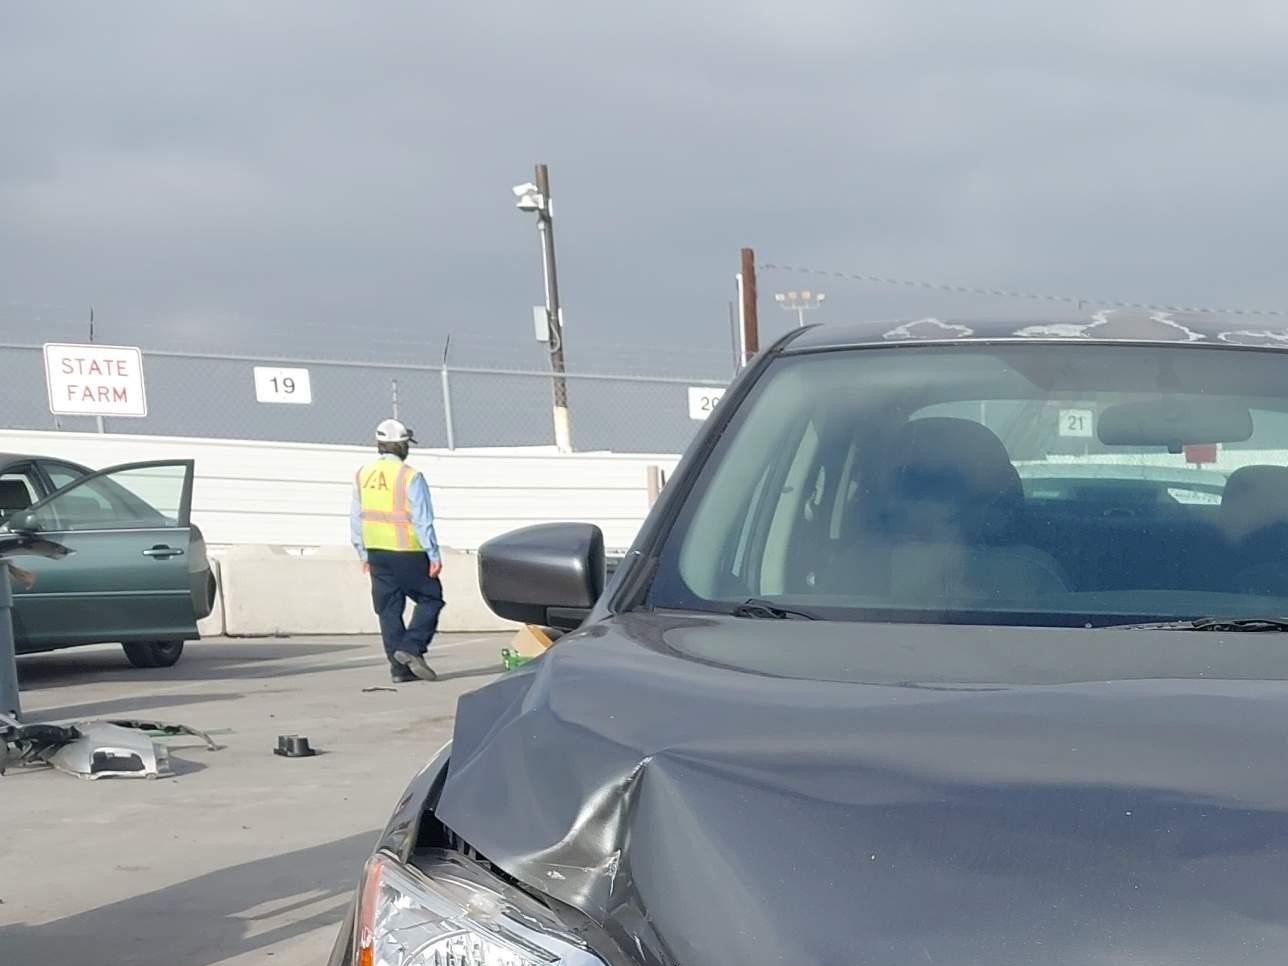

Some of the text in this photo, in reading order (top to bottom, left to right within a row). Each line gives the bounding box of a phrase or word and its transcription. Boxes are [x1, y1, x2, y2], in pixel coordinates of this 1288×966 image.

[61, 357, 130, 378] STATE
[66, 384, 129, 404] FARM
[269, 376, 297, 395] 19
[1067, 415, 1086, 432] 21
